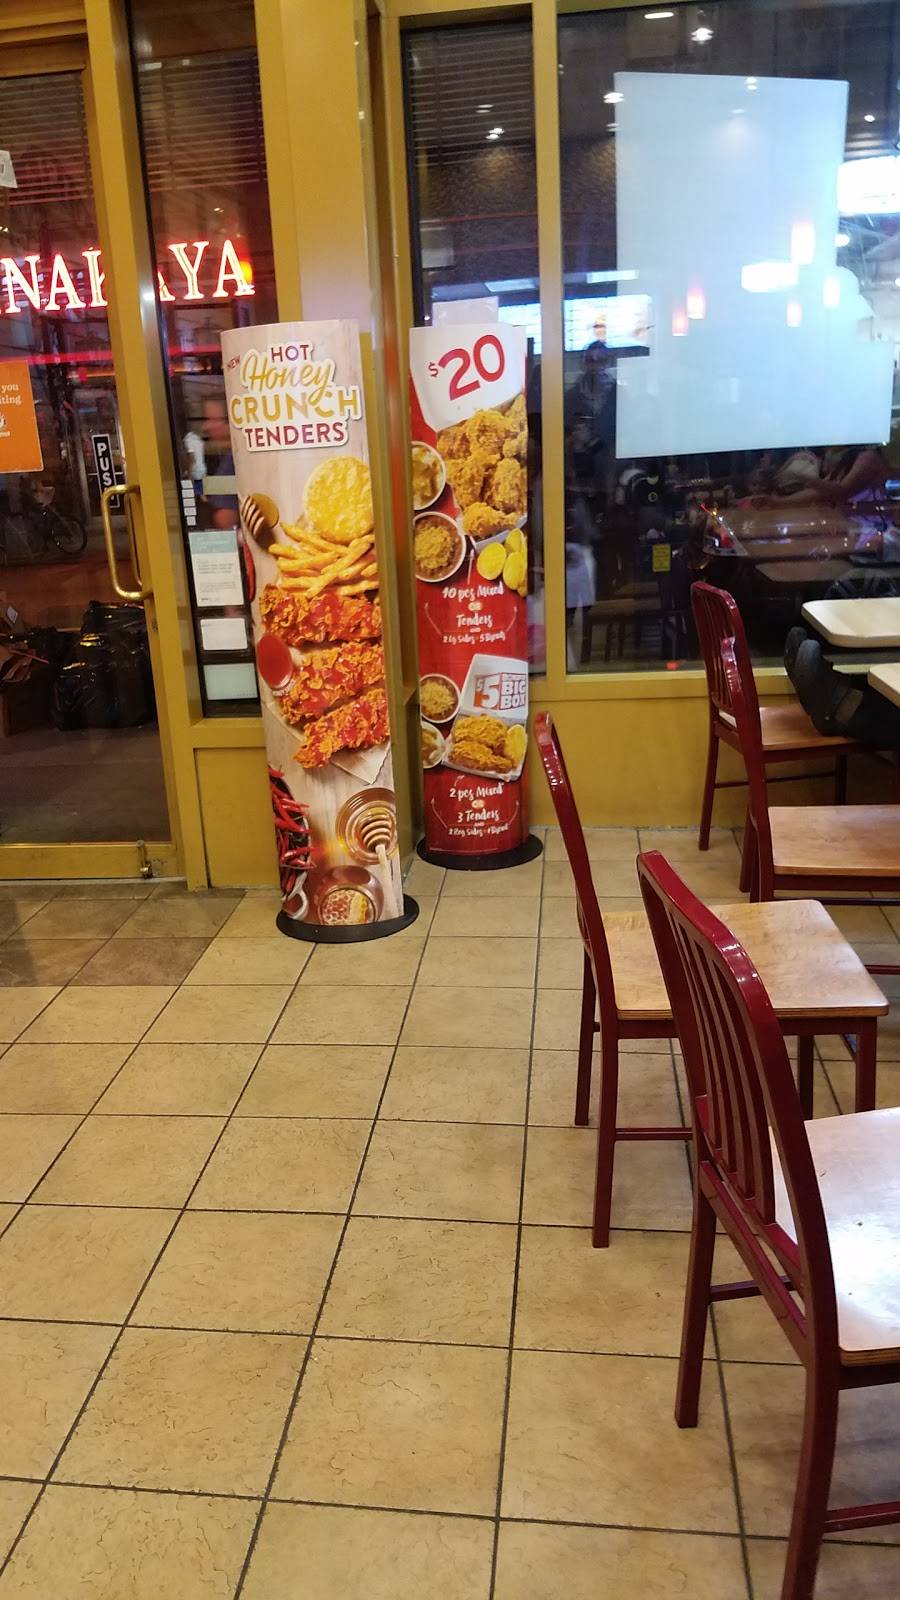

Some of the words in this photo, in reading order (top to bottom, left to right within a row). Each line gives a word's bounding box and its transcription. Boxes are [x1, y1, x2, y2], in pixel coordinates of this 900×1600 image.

[271, 344, 309, 362] HOT
[427, 334, 505, 400] $20
[242, 353, 332, 406] Honey
[1, 384, 19, 393] you
[231, 390, 358, 425] CRUNCH
[244, 422, 345, 448] TENDERS
[442, 587, 456, 598] 10
[456, 612, 493, 628] Tenders
[501, 680, 526, 694] BIG
[449, 788, 456, 797] 2
[457, 812, 463, 822] 3
[465, 808, 500, 822] Tenders
